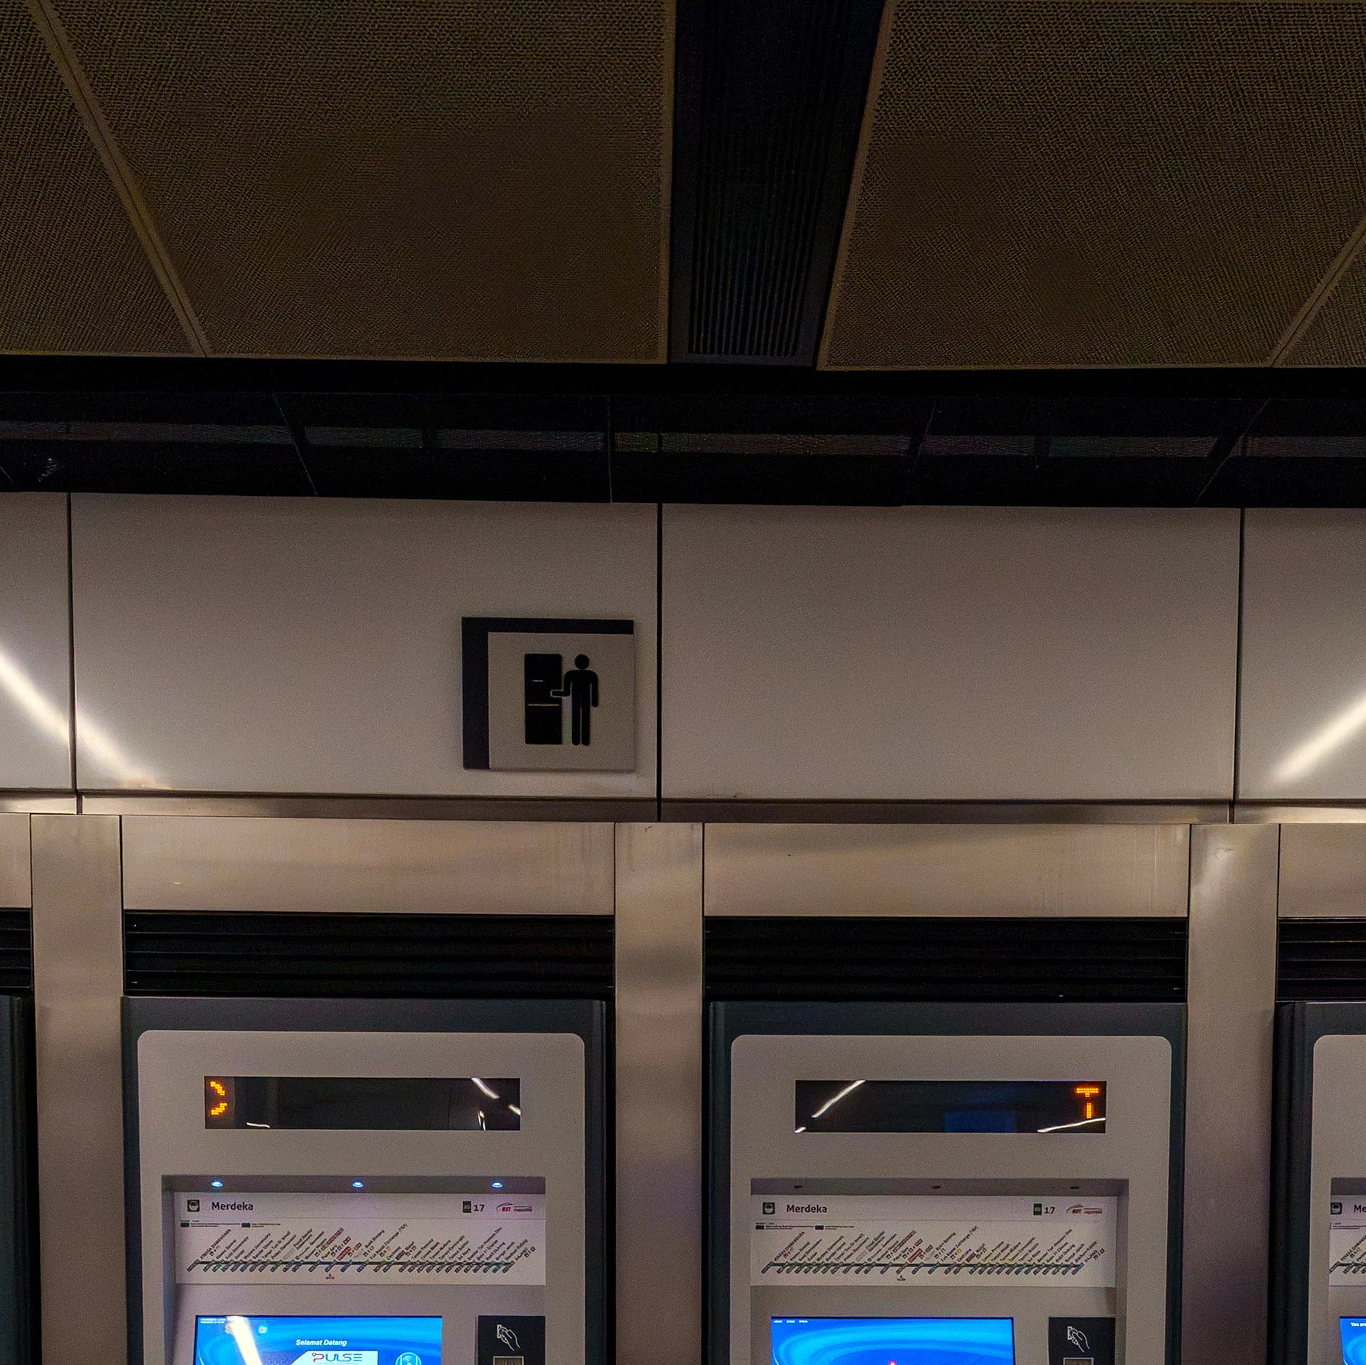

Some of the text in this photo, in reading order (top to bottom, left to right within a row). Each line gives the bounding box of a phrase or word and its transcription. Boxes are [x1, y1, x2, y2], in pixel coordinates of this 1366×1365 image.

[1074, 1086, 1100, 1119] T
[211, 1202, 254, 1211] Merdeka
[473, 1204, 485, 1212] 17
[786, 1204, 828, 1214] Merdeka
[1043, 1206, 1056, 1215] 17
[323, 1339, 348, 1347] Datang
[311, 1352, 363, 1363] PULSE
